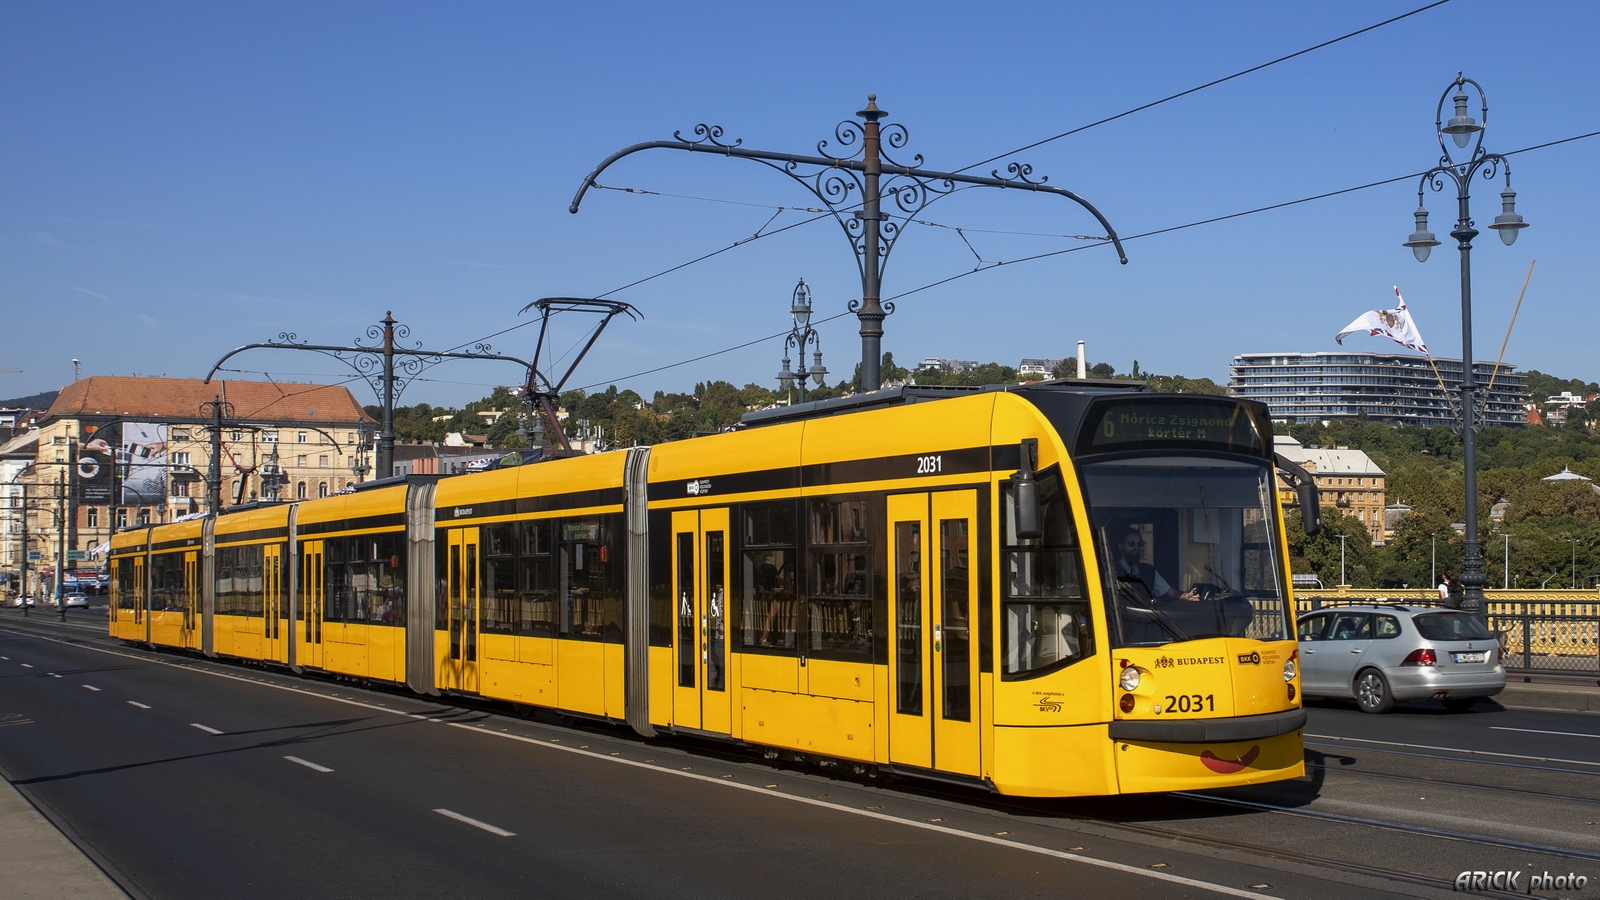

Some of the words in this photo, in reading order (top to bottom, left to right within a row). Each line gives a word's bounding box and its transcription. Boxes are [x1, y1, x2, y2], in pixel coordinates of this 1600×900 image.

[1103, 412, 1114, 437] 6
[1121, 412, 1165, 424] Móricz
[1170, 415, 1232, 426] Zsigmond
[1148, 427, 1191, 438] körtér
[1197, 429, 1206, 438] M
[917, 455, 941, 473] 2031
[1177, 657, 1225, 666] BUDAPEST
[1165, 694, 1214, 713] 2031
